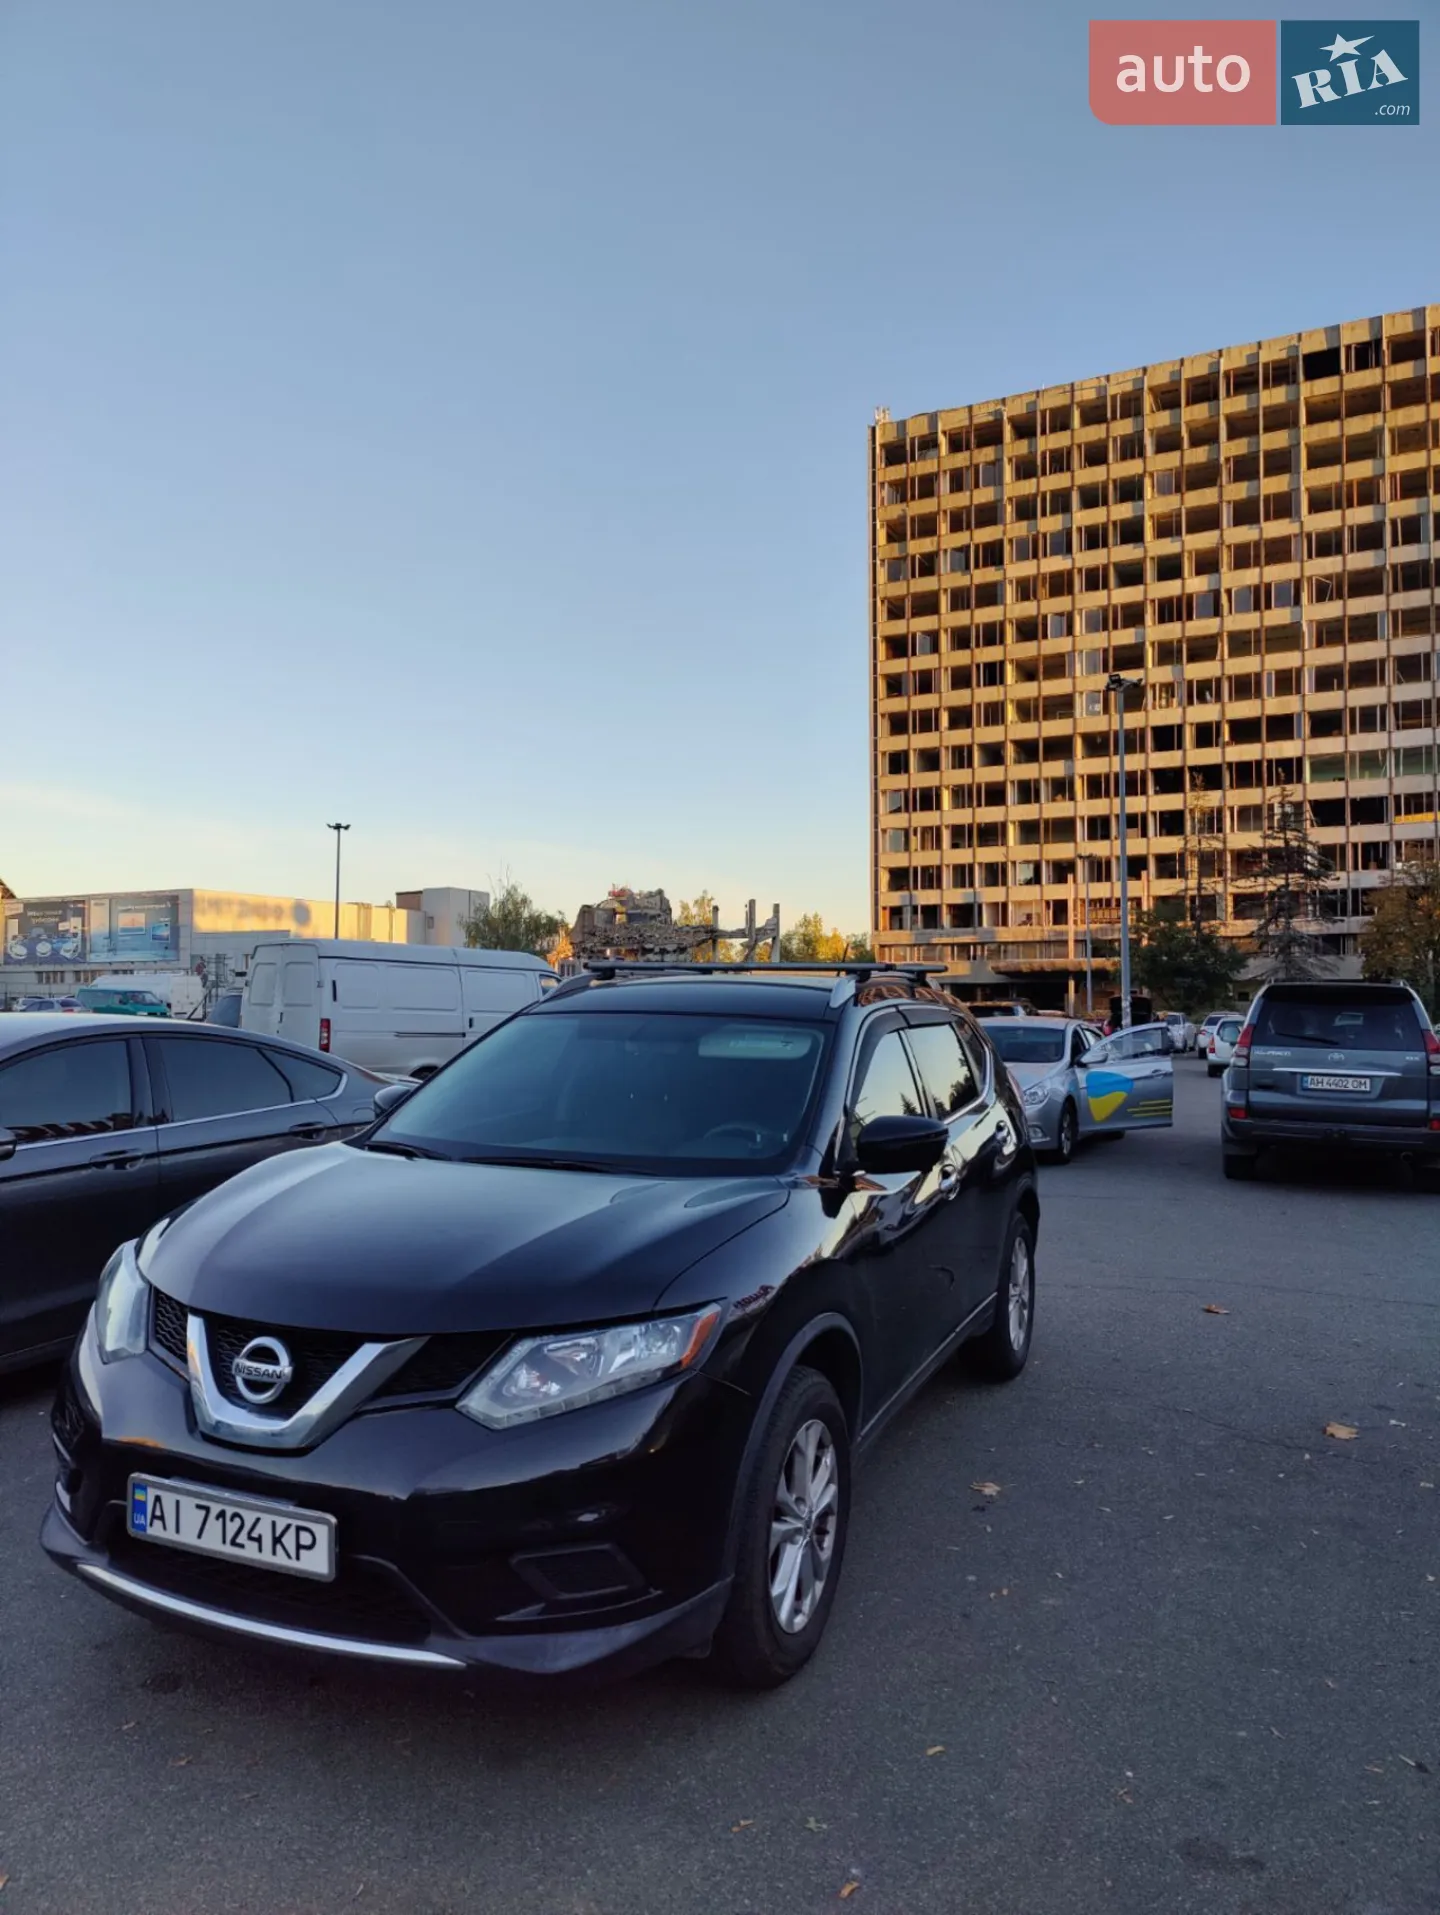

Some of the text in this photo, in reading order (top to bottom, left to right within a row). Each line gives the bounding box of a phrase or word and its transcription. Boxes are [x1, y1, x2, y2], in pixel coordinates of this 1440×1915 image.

[1310, 1077, 1324, 1088] AH
[1326, 1078, 1349, 1089] 4402
[235, 1362, 284, 1380] NISSAN
[134, 1513, 146, 1526] UA
[149, 1494, 317, 1562] AI 7124 KP
